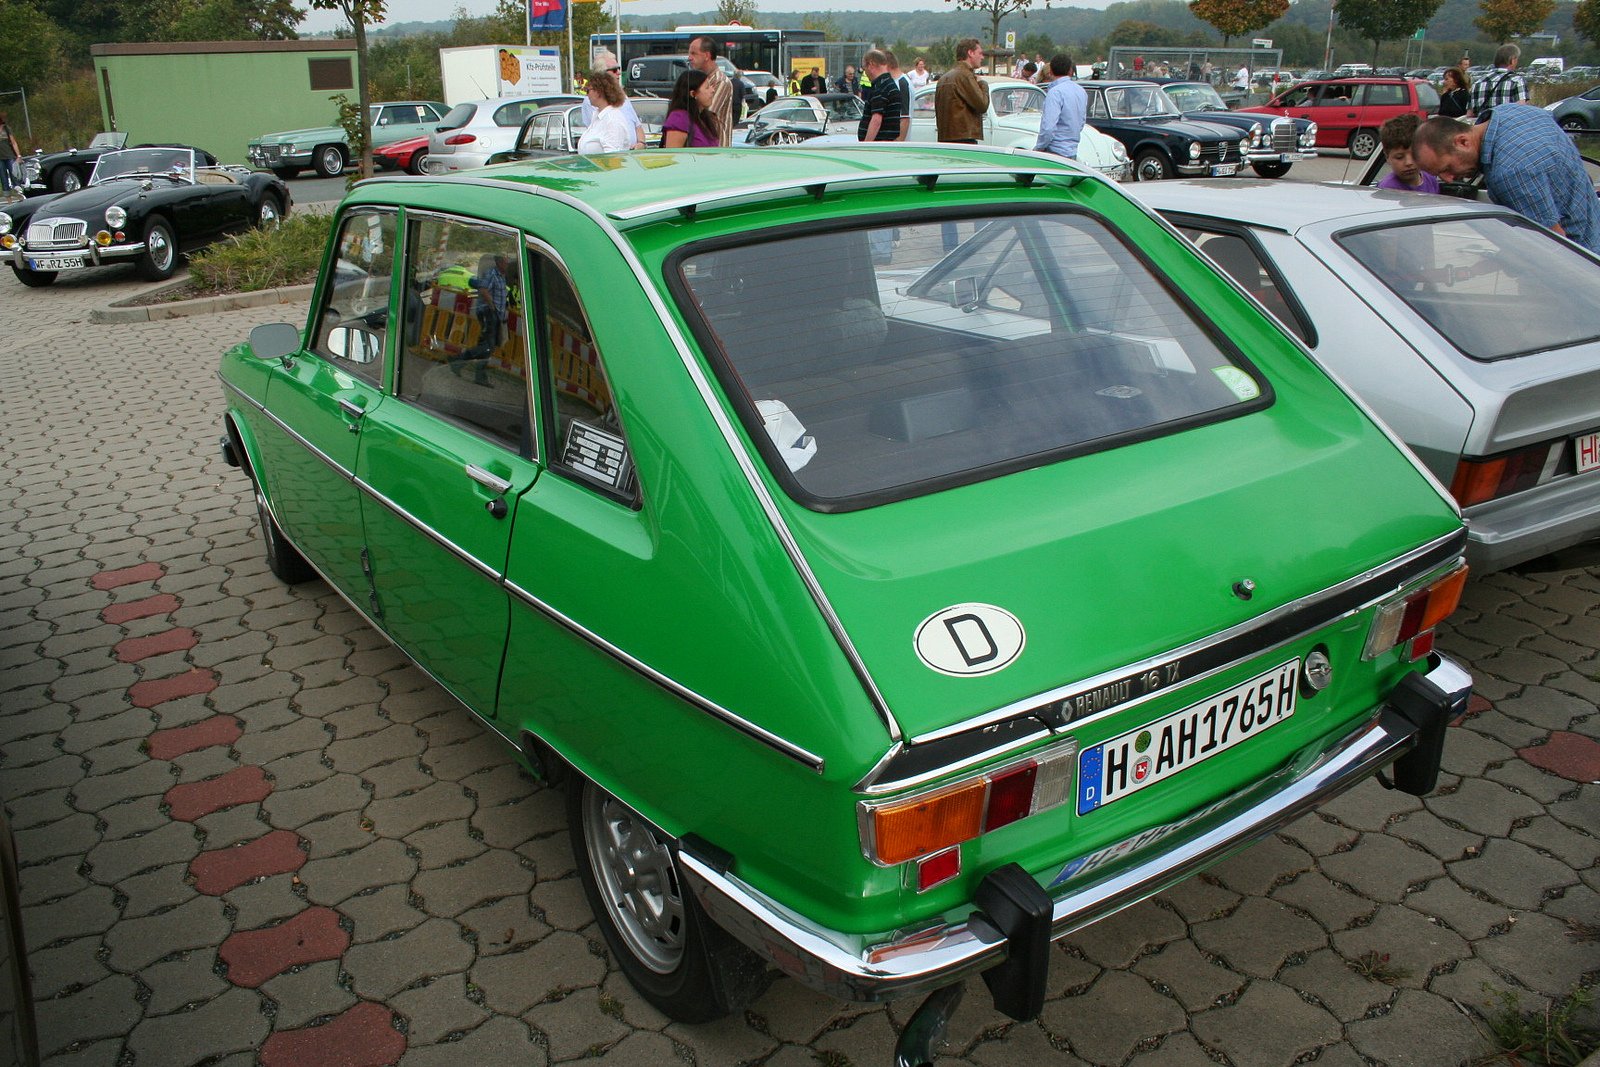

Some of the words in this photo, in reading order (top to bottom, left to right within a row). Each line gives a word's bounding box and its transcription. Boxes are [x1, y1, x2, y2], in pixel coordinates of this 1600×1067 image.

[526, 63, 556, 71] Kfz-Prüfstelle
[35, 260, 45, 269] WF
[50, 259, 63, 268] RZ
[64, 258, 83, 267] 55H
[943, 613, 998, 667] D
[1076, 679, 1131, 717] RENAULT
[1141, 669, 1160, 692] 16
[1165, 661, 1181, 684] TX
[1106, 743, 1129, 796] H
[1086, 786, 1095, 801] D
